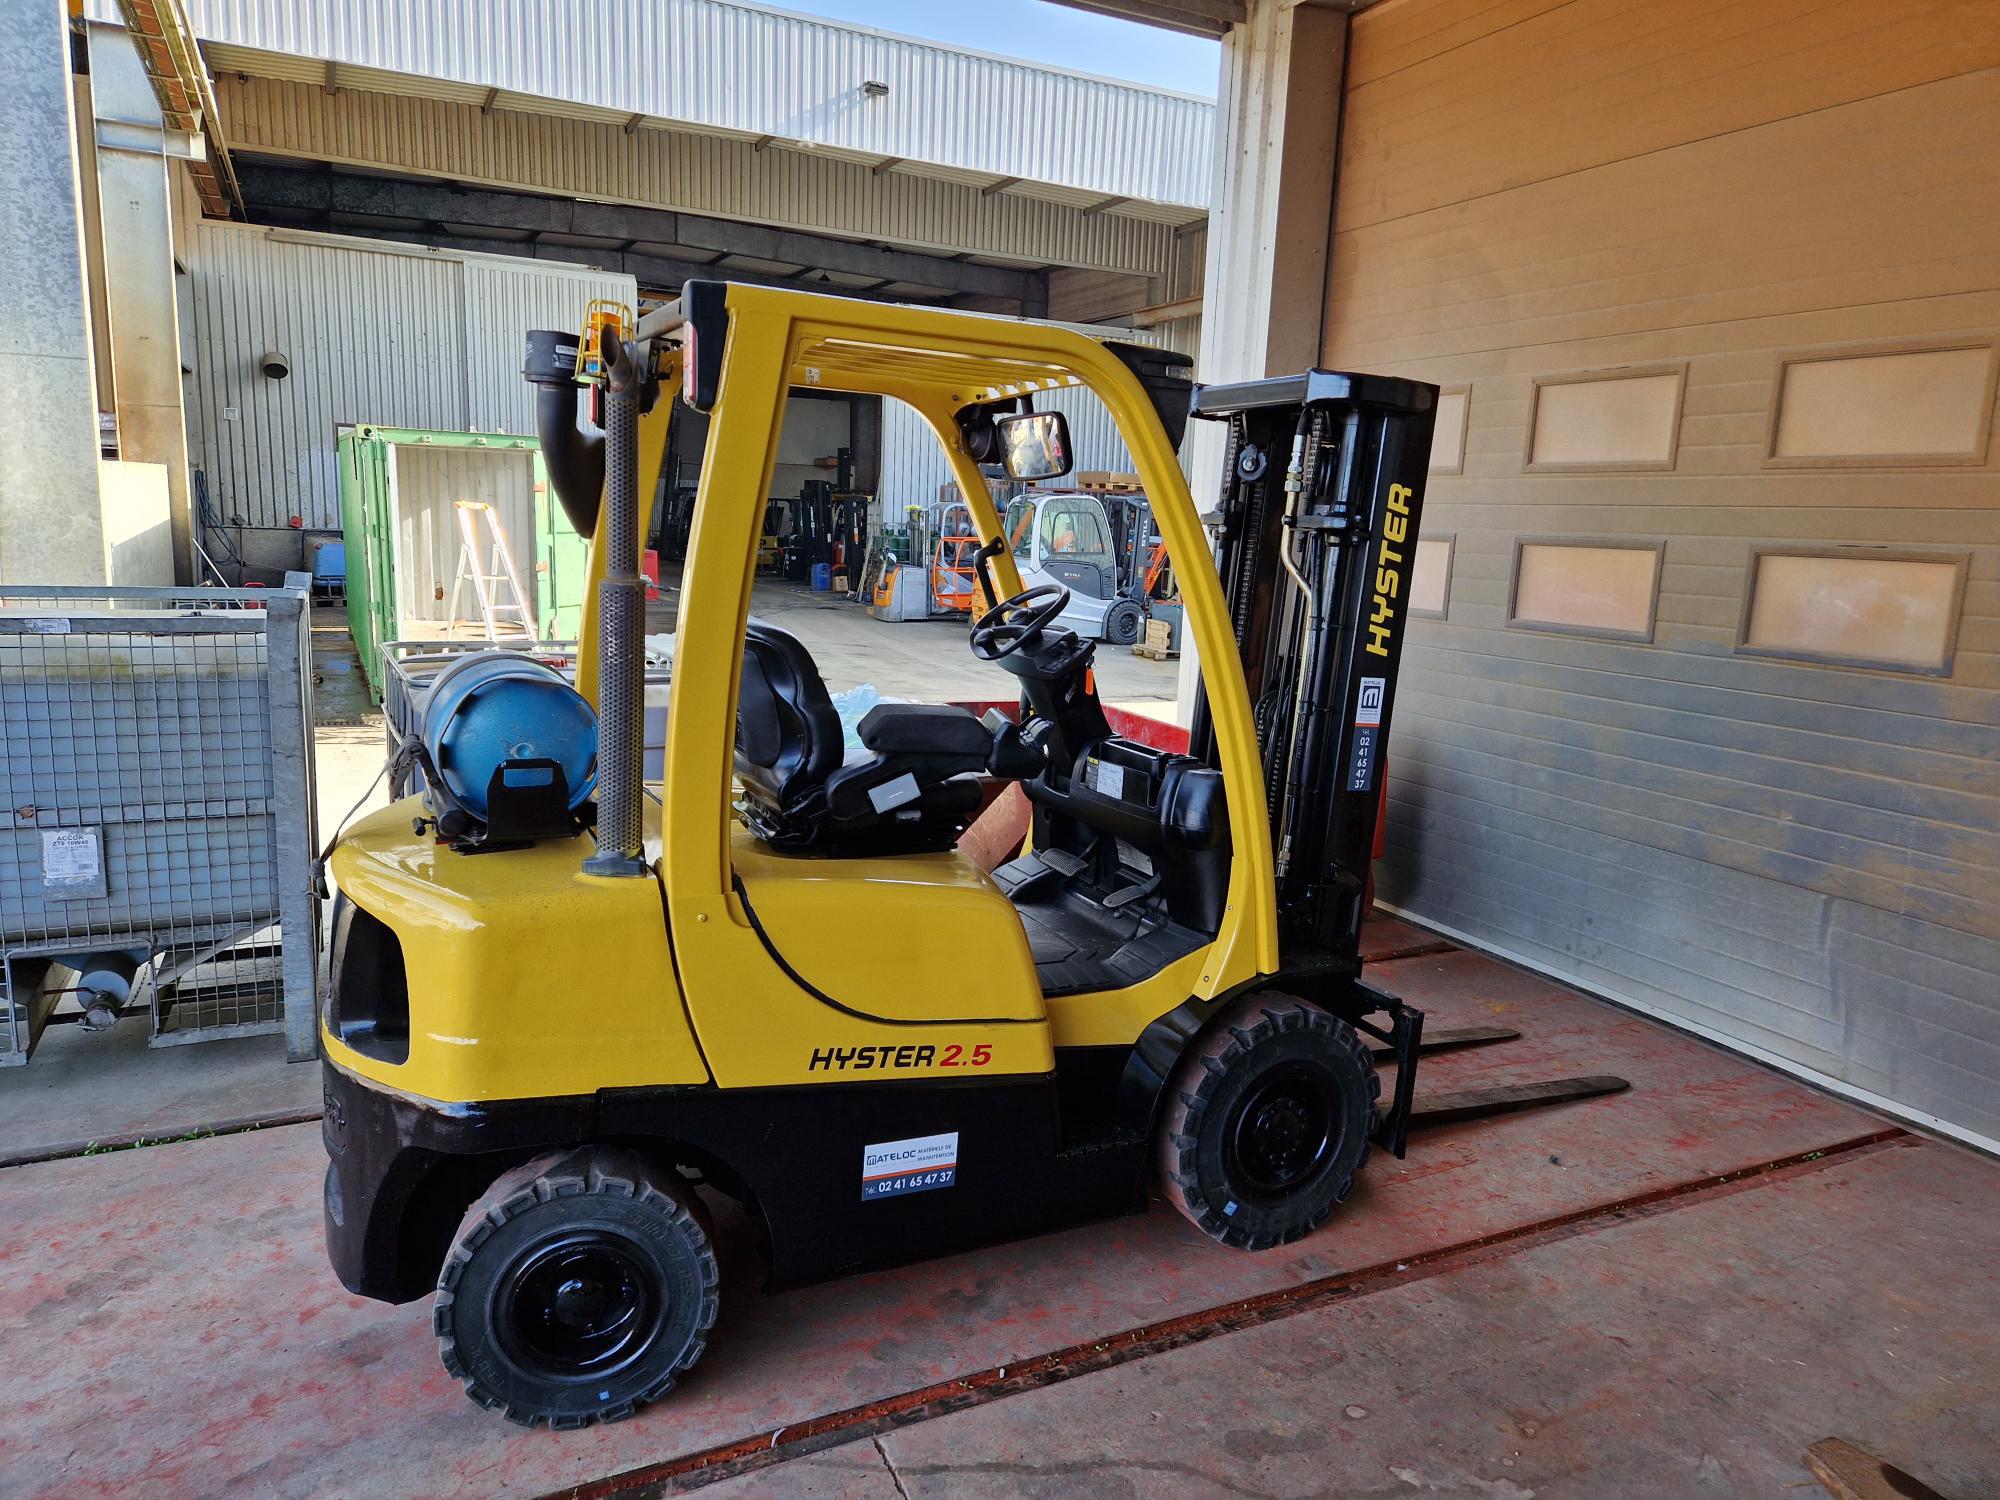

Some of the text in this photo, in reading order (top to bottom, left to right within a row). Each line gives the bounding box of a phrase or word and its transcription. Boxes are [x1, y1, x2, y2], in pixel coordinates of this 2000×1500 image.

[1366, 482, 1412, 657] HYSTER
[1360, 737, 1370, 746] 02
[1358, 747, 1368, 757] 41
[1357, 758, 1367, 767] 65
[1355, 769, 1366, 779] 47
[1354, 780, 1365, 789] 37
[808, 1044, 993, 1071] HYSTER 2.5
[917, 1151, 955, 1162] MANUTENTION
[878, 1181, 892, 1193] 02
[894, 1178, 906, 1190] 41
[909, 1175, 922, 1188] 65
[924, 1173, 937, 1185] 47
[939, 1171, 953, 1182] 37
